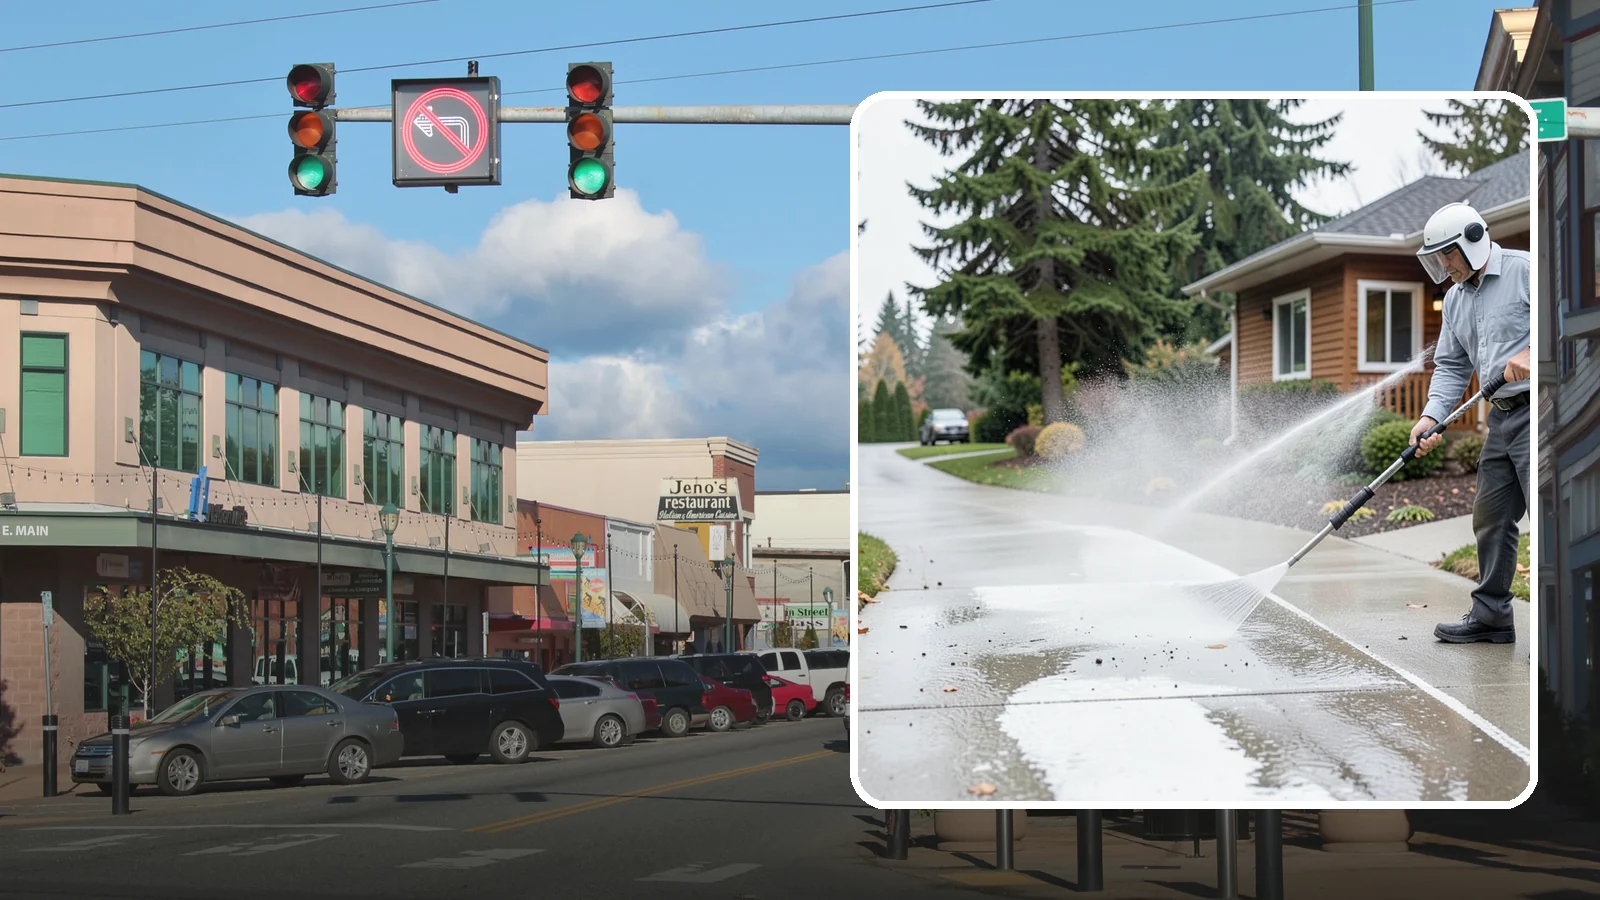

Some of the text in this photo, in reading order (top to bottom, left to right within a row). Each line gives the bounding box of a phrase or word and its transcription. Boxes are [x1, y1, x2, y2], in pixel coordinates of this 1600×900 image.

[670, 480, 727, 494] Jeno's
[665, 496, 731, 509] restaurant
[659, 509, 681, 519] Italian
[686, 509, 714, 519] American
[715, 509, 737, 519] Cuisine
[2, 525, 49, 536] E. MAIN
[797, 607, 828, 617] Street
